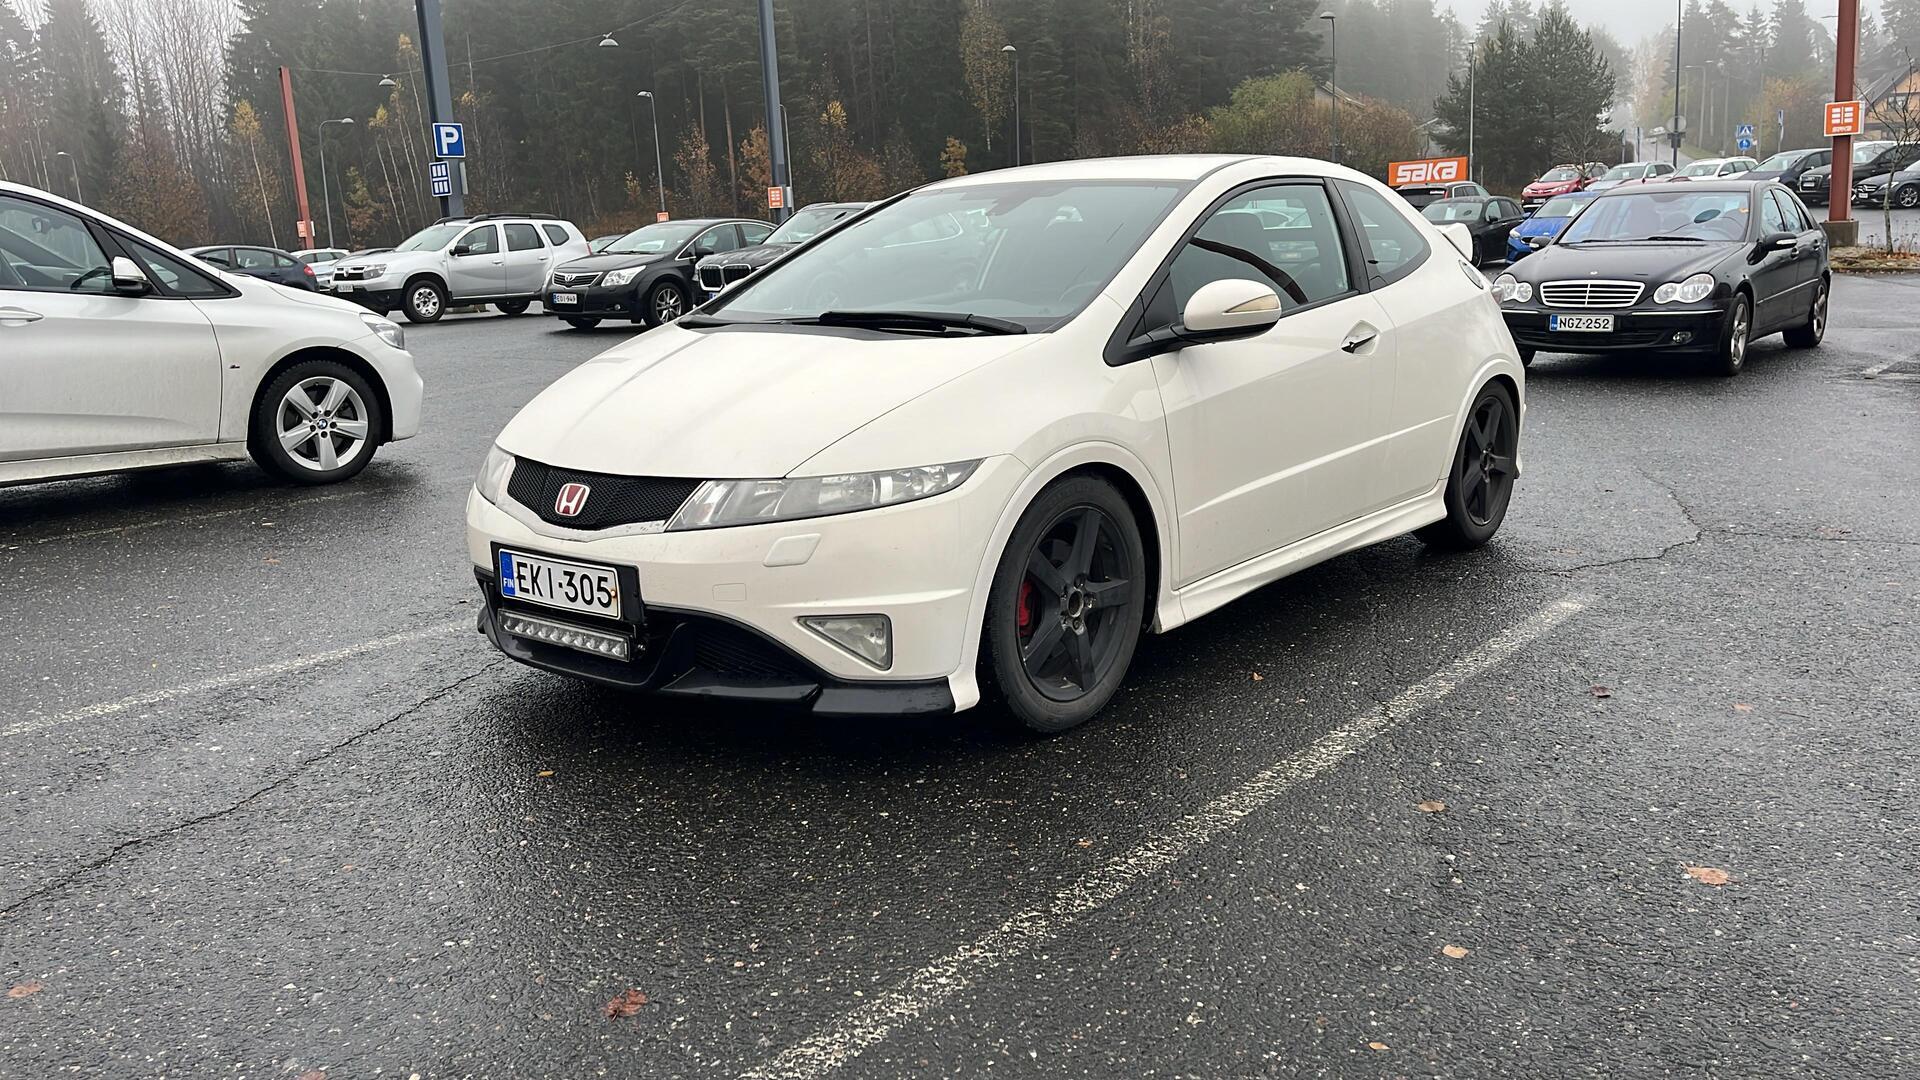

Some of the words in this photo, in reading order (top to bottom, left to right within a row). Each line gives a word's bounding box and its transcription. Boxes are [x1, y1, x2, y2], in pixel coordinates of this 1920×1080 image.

[440, 126, 459, 154] P
[1559, 318, 1610, 330] NGZ-252
[516, 561, 612, 608] EKI-305
